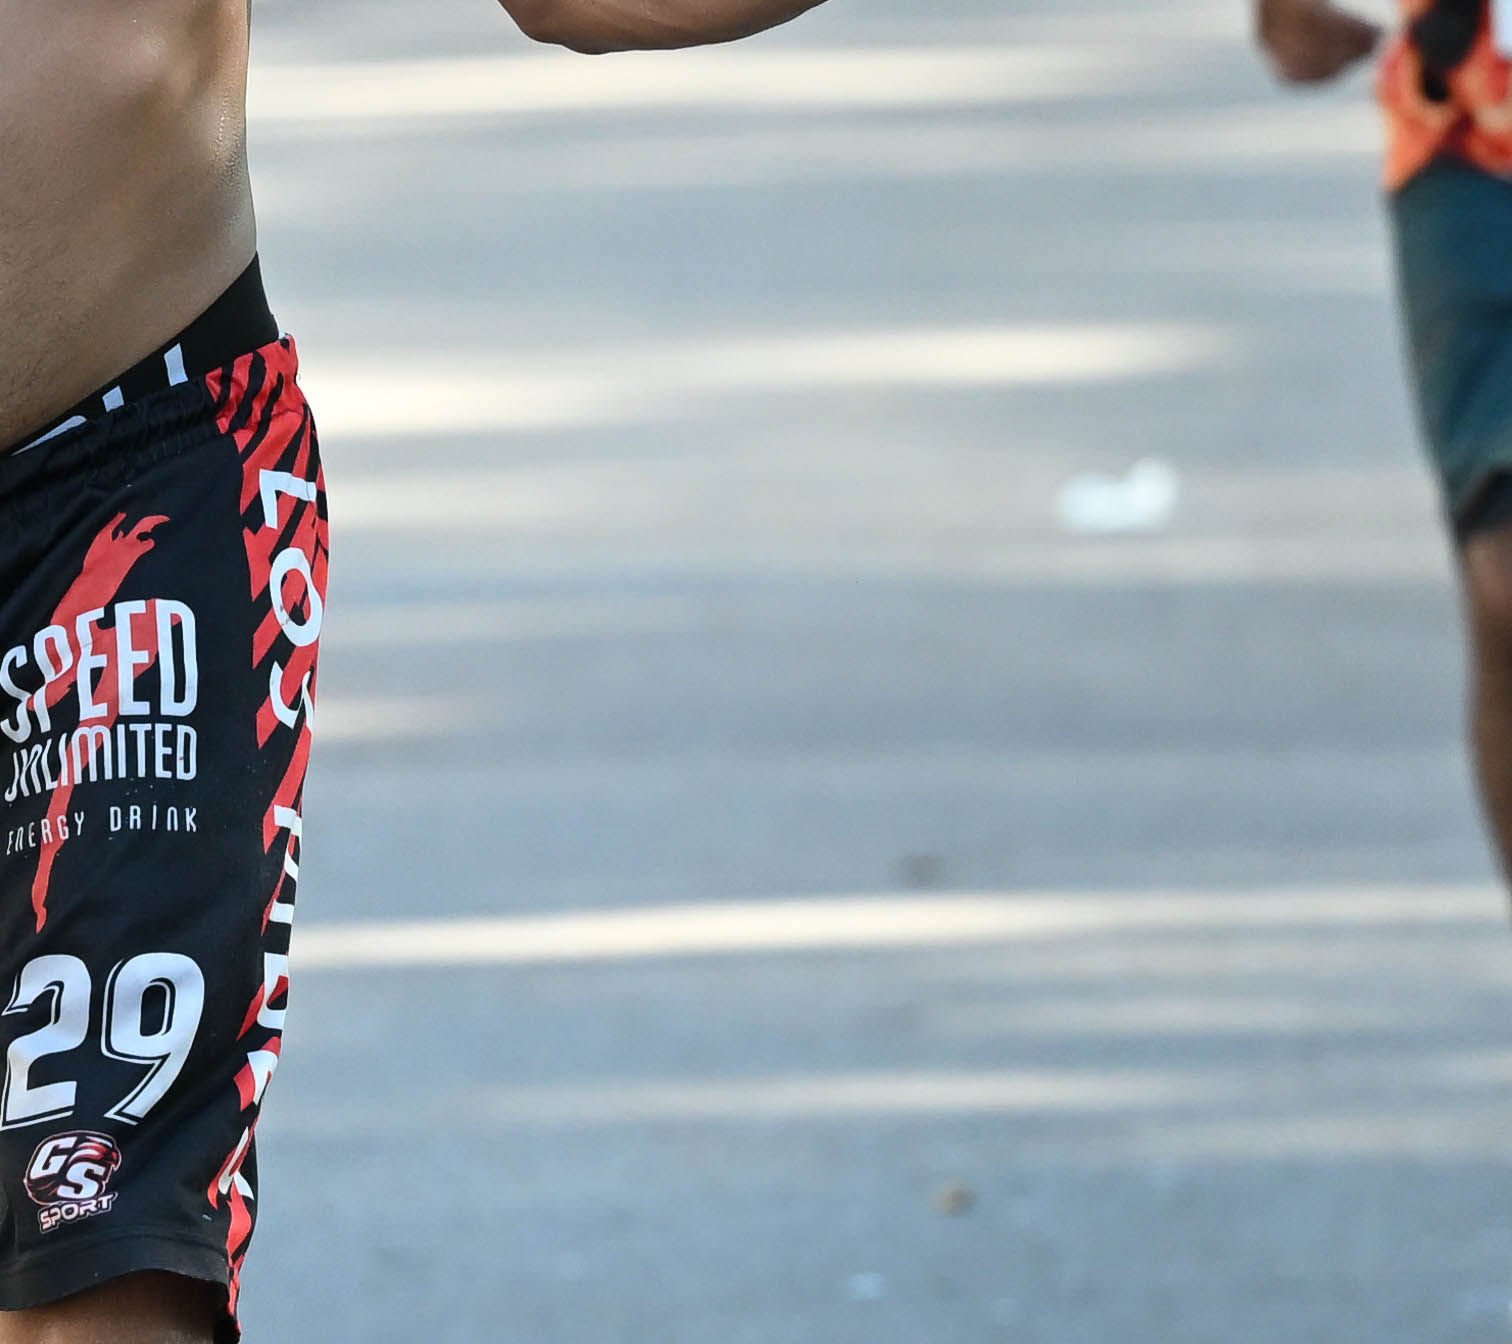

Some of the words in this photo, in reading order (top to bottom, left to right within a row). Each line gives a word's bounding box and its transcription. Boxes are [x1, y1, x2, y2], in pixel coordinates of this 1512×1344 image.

[259, 467, 323, 734] LOS
[0, 598, 198, 743] SPEED
[4, 722, 198, 802] UNLIMITED
[6, 811, 85, 856] ENERGY
[109, 804, 197, 833] DRINK
[0, 952, 205, 1131] 29
[40, 1194, 115, 1230] SPORT
